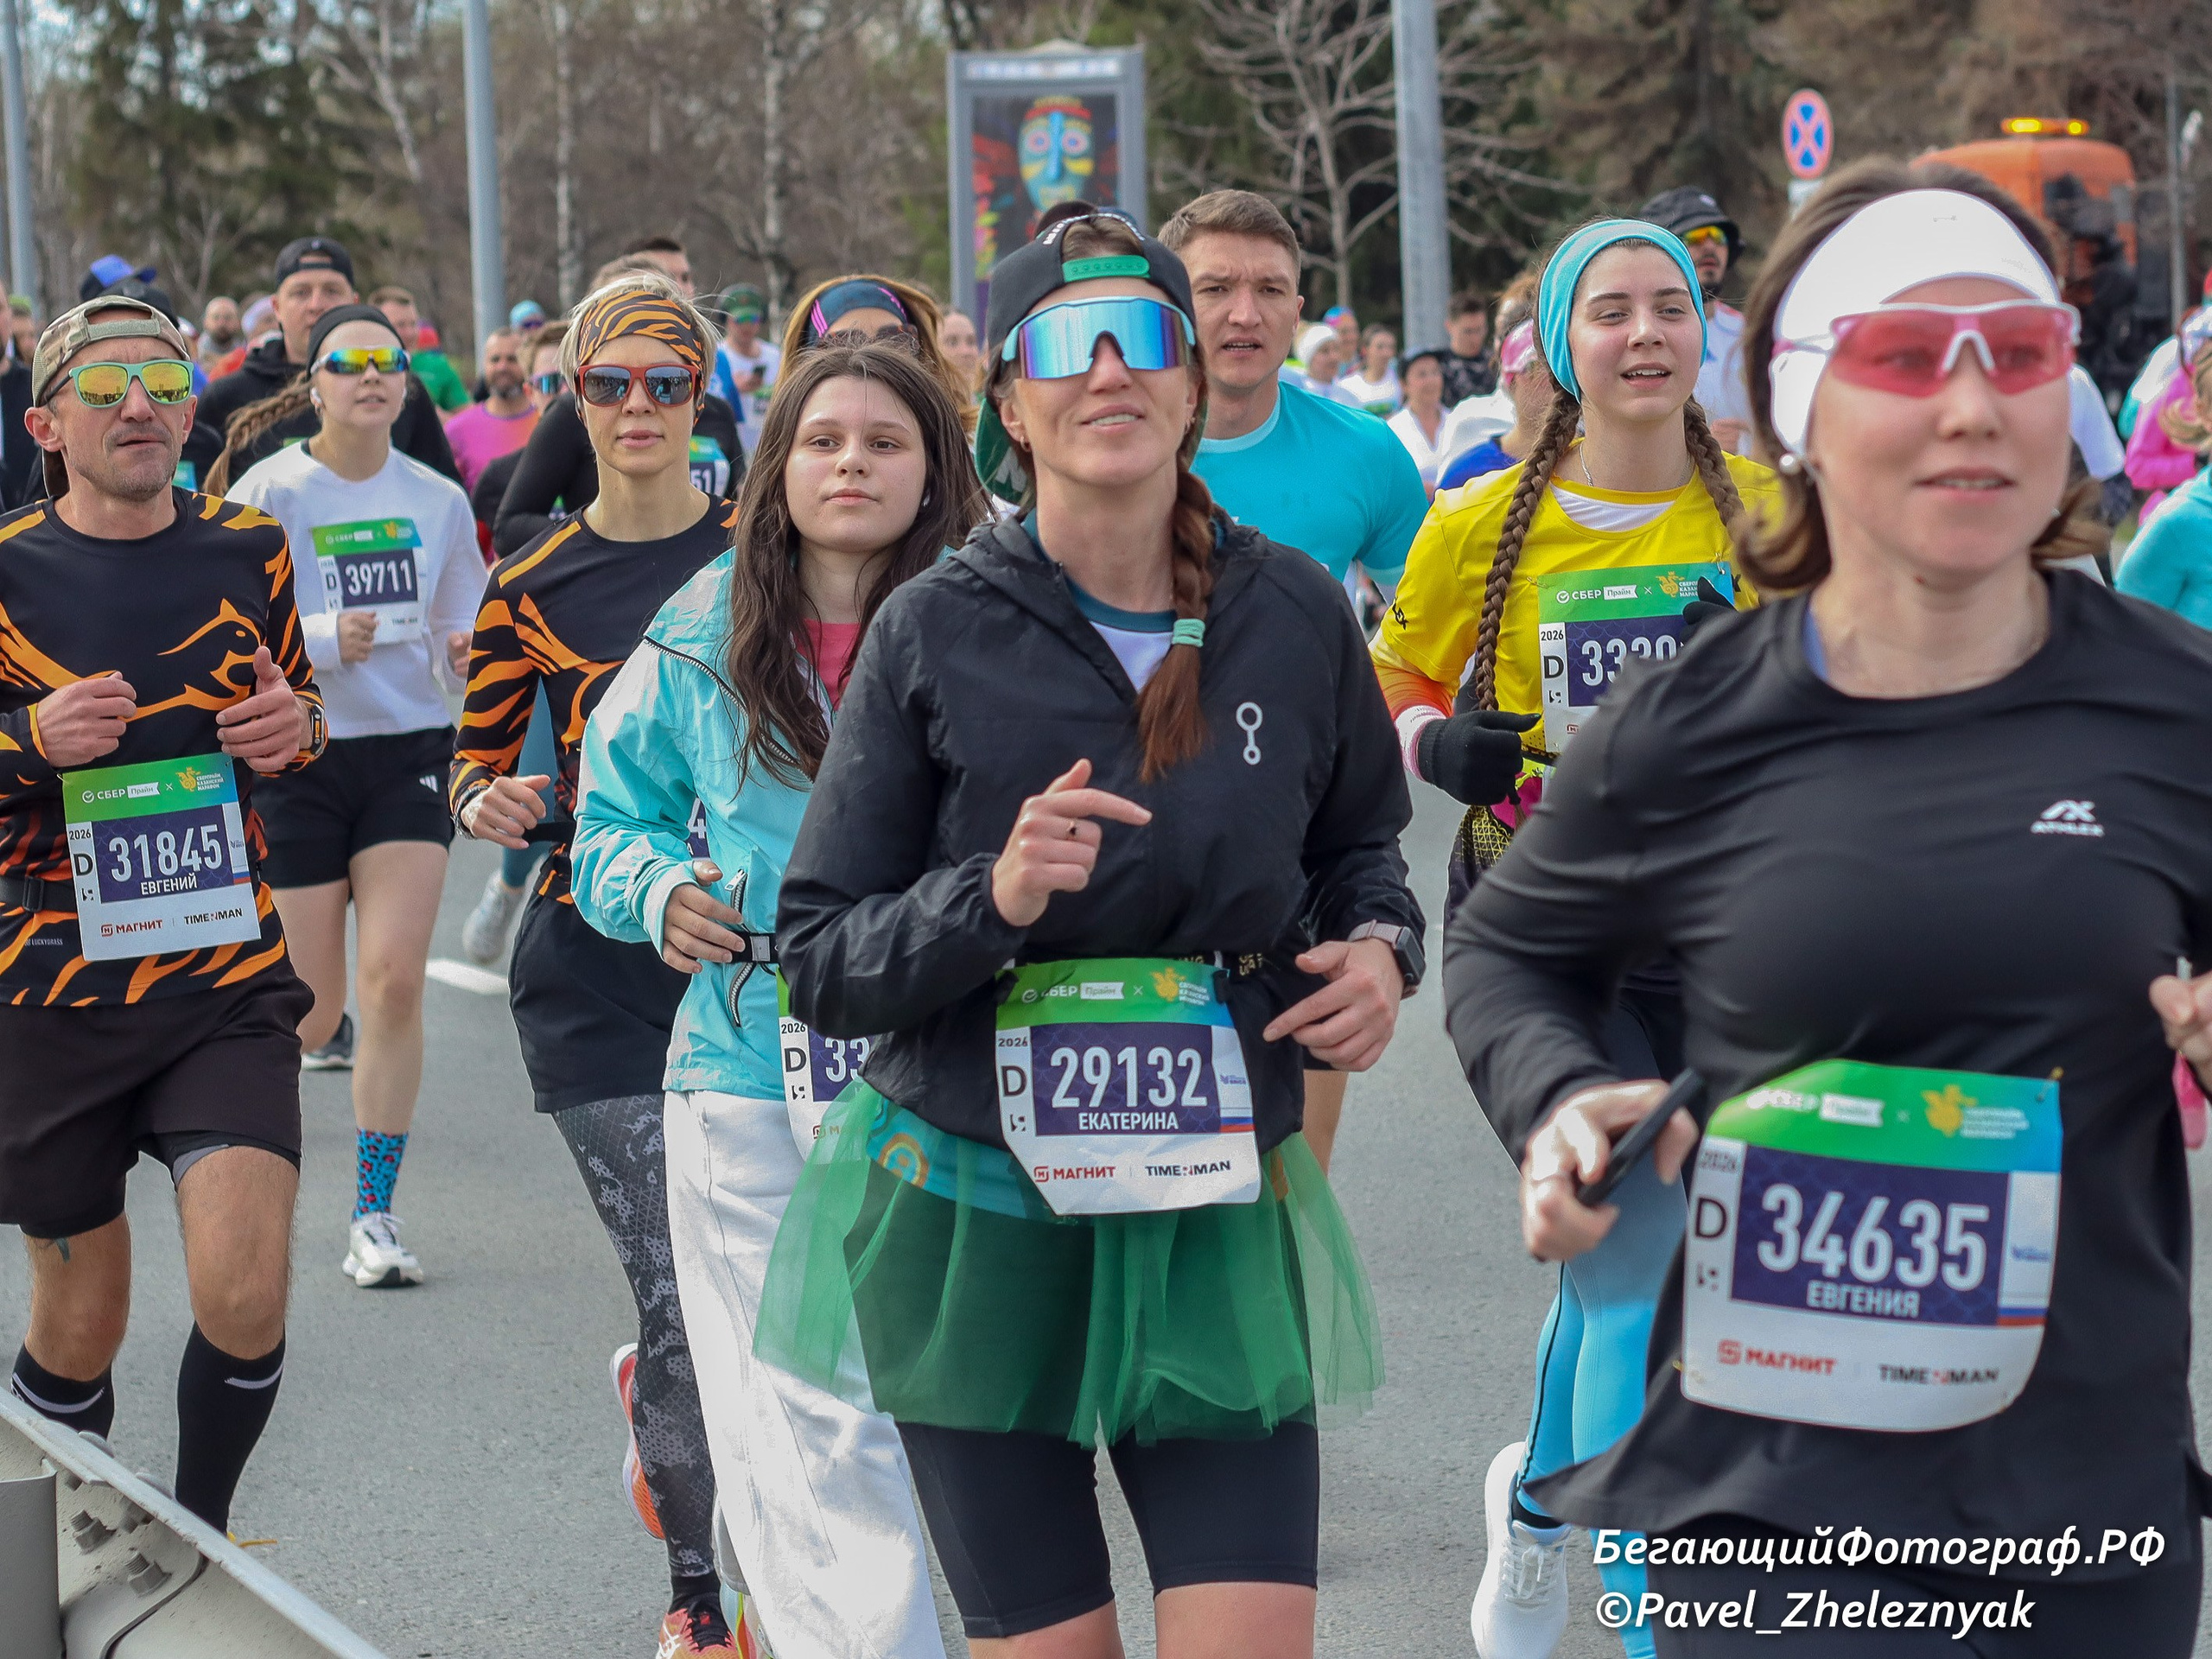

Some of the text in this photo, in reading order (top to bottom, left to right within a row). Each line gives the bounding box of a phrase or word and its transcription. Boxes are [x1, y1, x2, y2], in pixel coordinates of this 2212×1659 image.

[346, 559, 412, 597] 39711
[1572, 589, 1602, 600] СБЕР
[1541, 629, 1564, 641] 2026
[1543, 655, 1565, 678] D
[97, 789, 126, 800] СБЕР
[69, 829, 92, 841] 2026
[108, 823, 223, 882] 31845
[73, 853, 93, 876] D
[140, 873, 198, 895] ЕВГЕНИЙ
[116, 919, 163, 934] МАГНИТ
[781, 1023, 806, 1034] 2026
[998, 1037, 1028, 1047] 2026
[784, 1047, 807, 1072] D
[1001, 1065, 1027, 1097] D
[1050, 1046, 1208, 1108] 29132
[1078, 1112, 1179, 1131] ЕКАТЕРИНА
[1053, 1166, 1116, 1180] МАГНИТ
[1695, 1198, 1727, 1238] D
[1757, 1183, 1990, 1293] 34635
[1807, 1279, 1921, 1319] ЕВГЕНИЯ
[1745, 1347, 1837, 1376] МАГНИТ
